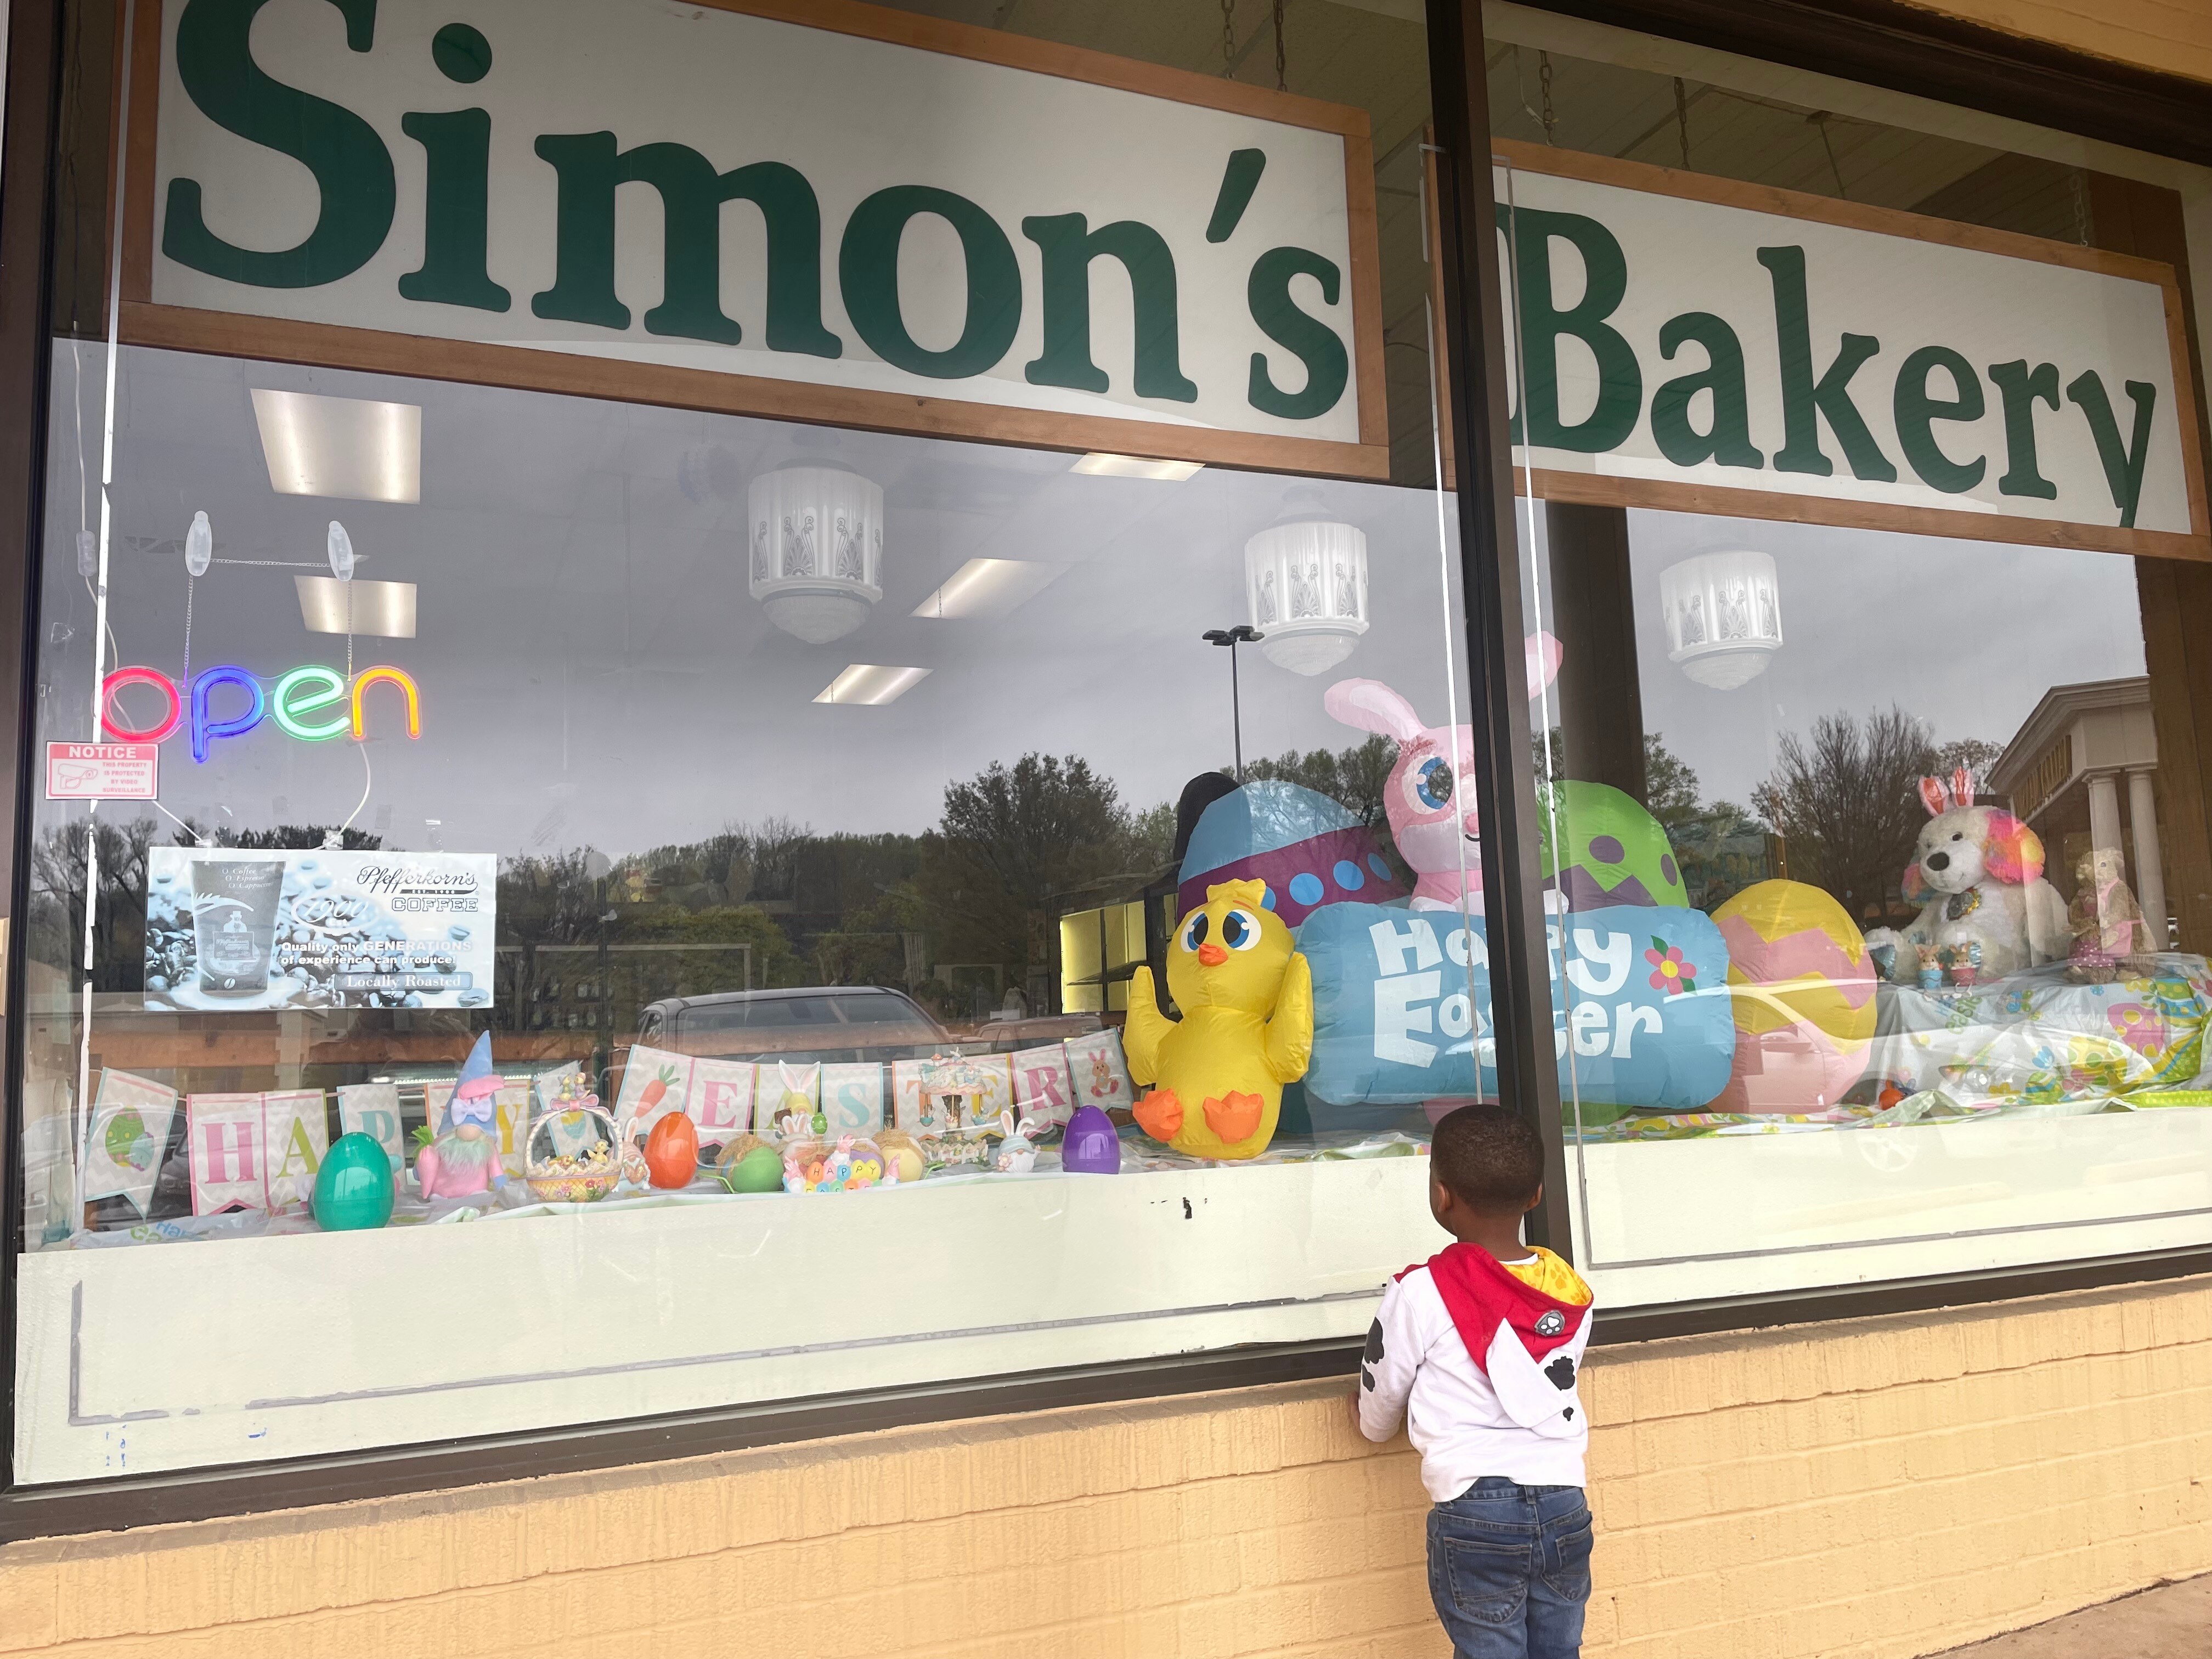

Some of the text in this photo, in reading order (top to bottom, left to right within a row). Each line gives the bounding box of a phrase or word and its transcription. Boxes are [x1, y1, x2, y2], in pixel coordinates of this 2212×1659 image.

[162, 0, 2157, 527] Simon's Bakery
[100, 665, 422, 763] open
[69, 746, 137, 759] NOTICE
[233, 866, 256, 876] Coffee
[357, 865, 477, 894] Pfefferkorn's
[304, 900, 369, 923] 1900
[392, 897, 478, 912] COFFEE
[281, 940, 472, 953] Quality only GENERATIONS
[281, 955, 294, 964] of
[298, 956, 370, 965] experience
[402, 955, 456, 966] produce!
[1369, 918, 1633, 996] Hapy
[347, 974, 461, 990] Locally Roasted
[813, 1165, 877, 1177] HAPPY
